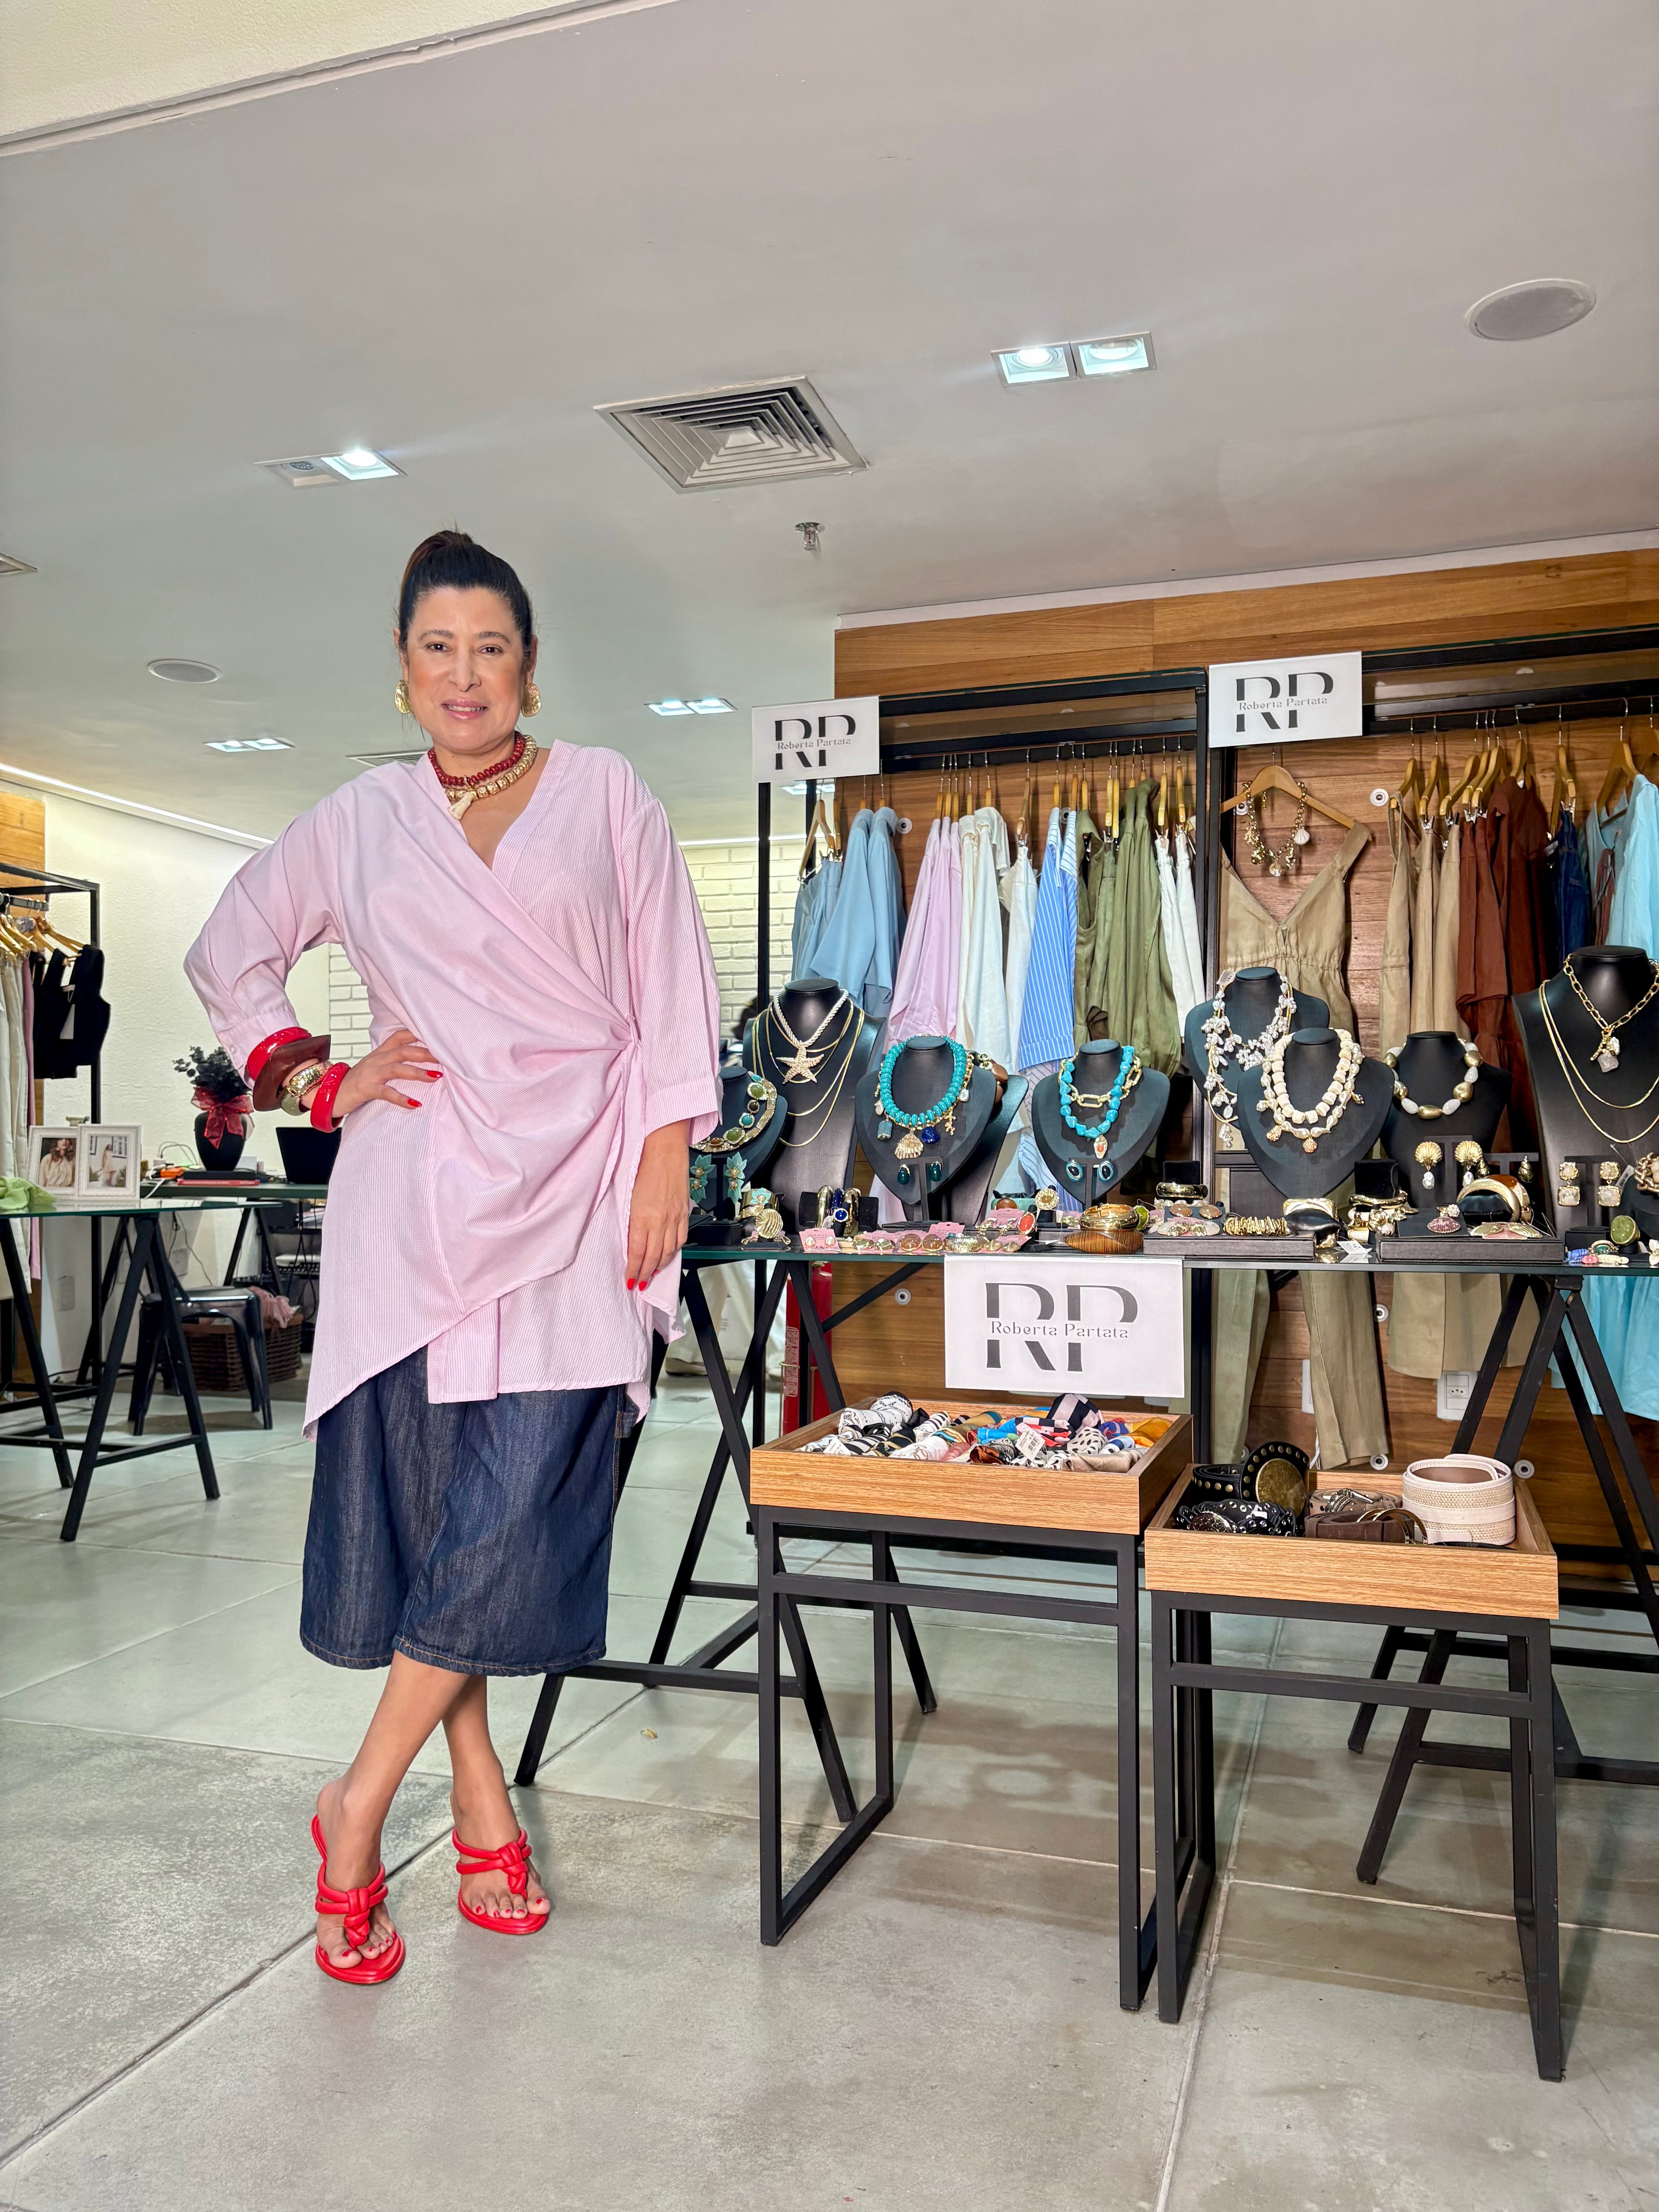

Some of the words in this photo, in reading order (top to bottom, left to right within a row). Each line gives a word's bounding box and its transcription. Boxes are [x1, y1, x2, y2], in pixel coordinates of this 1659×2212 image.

[1236, 672, 1334, 733] RP
[1239, 701, 1282, 711] Roberta
[1287, 697, 1328, 707] Partata
[775, 715, 856, 770] RP
[778, 741, 814, 750] Roberta
[817, 738, 851, 747] Partata
[985, 1282, 1138, 1372] RP
[992, 1321, 1057, 1336] Roberta
[1065, 1323, 1128, 1338] Partata
